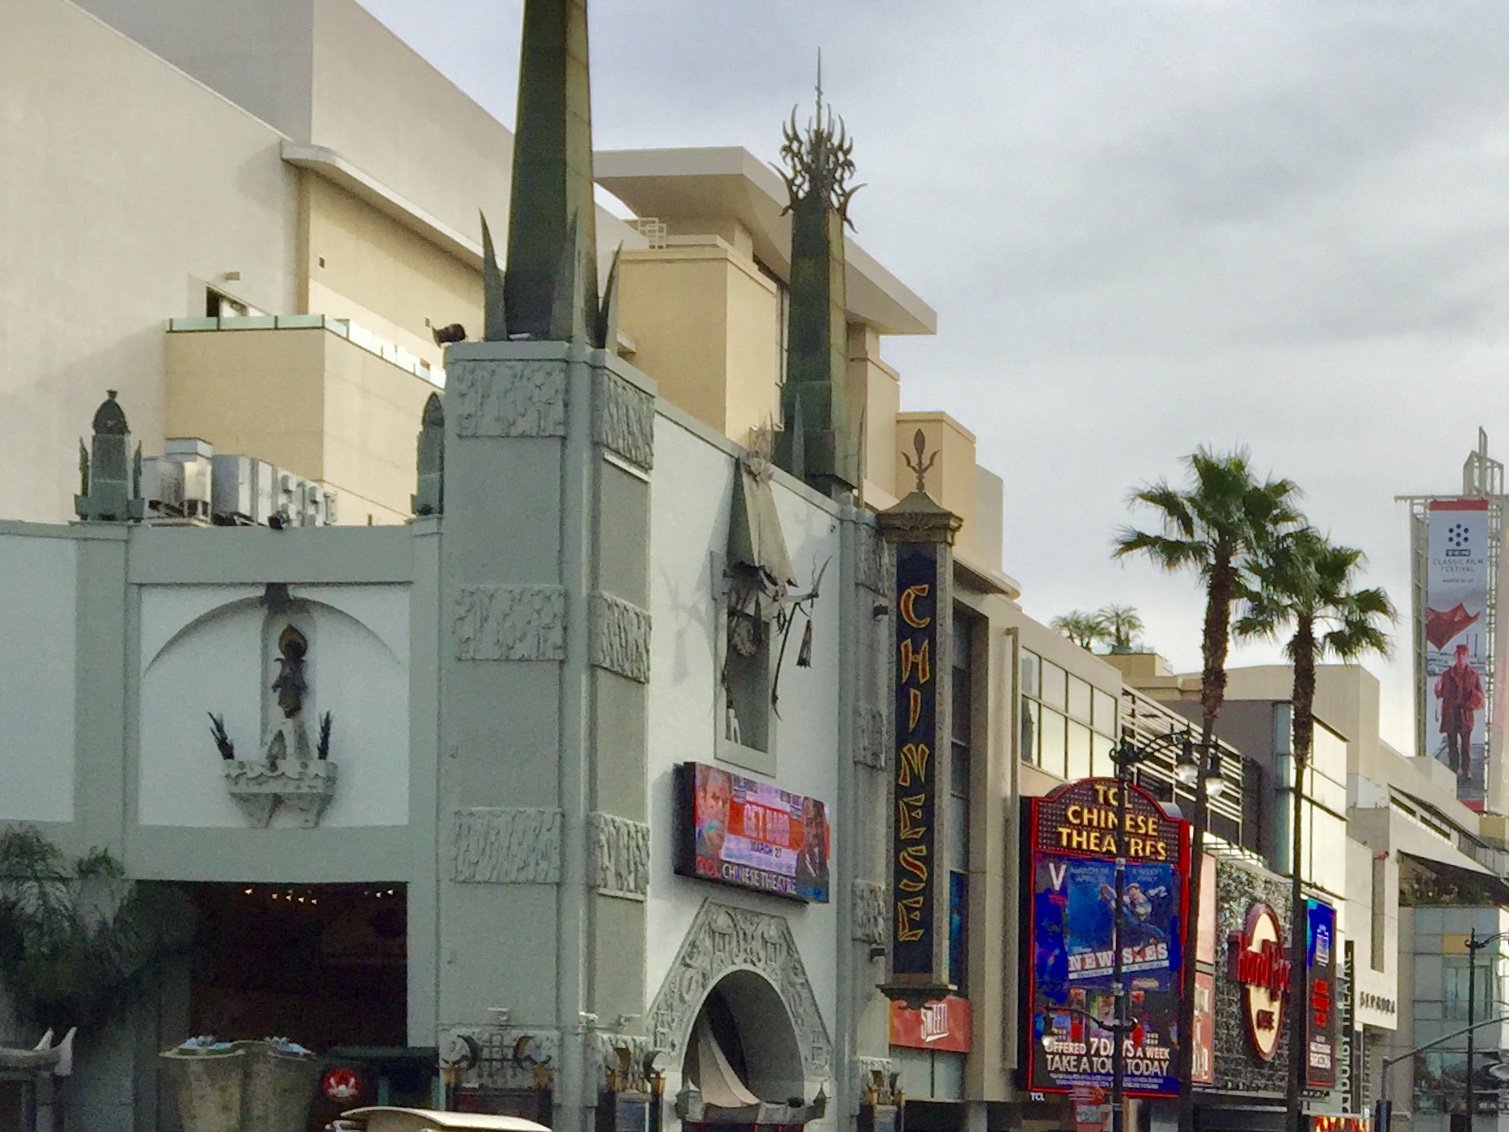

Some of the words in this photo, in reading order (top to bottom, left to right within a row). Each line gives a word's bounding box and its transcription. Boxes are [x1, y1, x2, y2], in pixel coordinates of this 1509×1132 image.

[899, 583, 931, 941] CHINESE
[1094, 784, 1133, 808] TCL
[1067, 805, 1158, 837] CHINESE
[1057, 827, 1167, 861] THEARES
[722, 863, 759, 886] CHINESE
[759, 872, 797, 894] THEATRE
[1359, 991, 1396, 1017] SEPHORA
[1090, 1037, 1098, 1056] 7
[1136, 1049, 1144, 1059] A
[1145, 1046, 1171, 1060] WEEK
[1046, 1054, 1079, 1072] TAKE
[1079, 1056, 1090, 1073] A
[1092, 1057, 1114, 1074] TOU
[1126, 1059, 1170, 1077] TODAY
[1030, 1092, 1045, 1101] TCL
